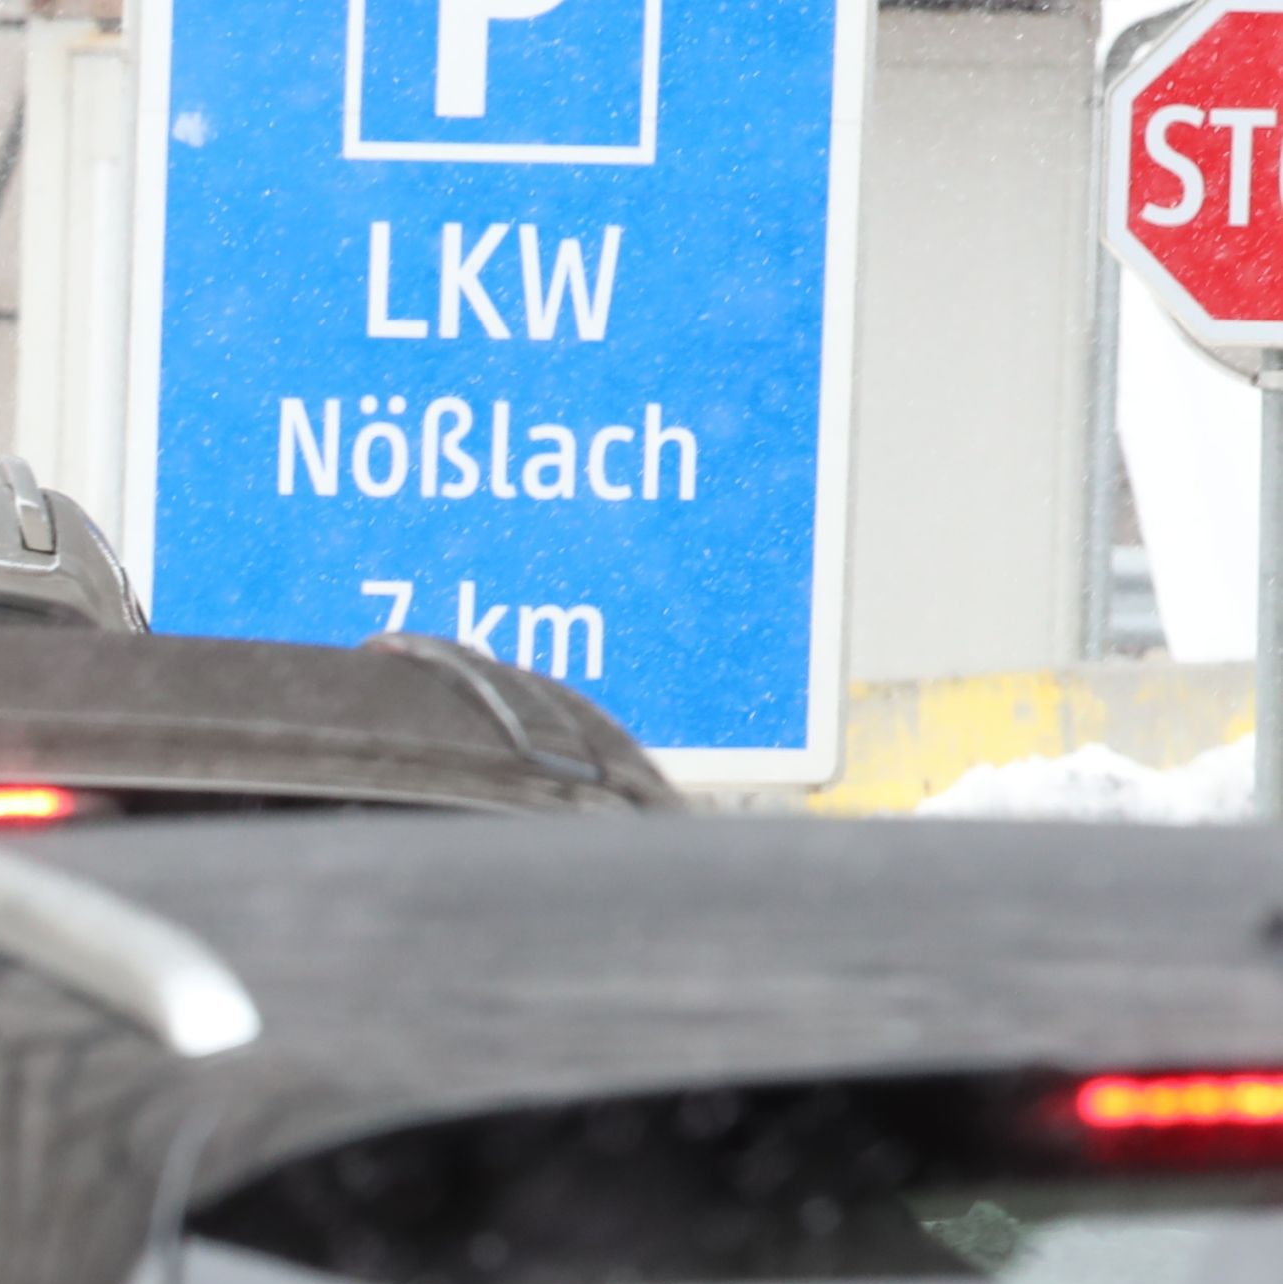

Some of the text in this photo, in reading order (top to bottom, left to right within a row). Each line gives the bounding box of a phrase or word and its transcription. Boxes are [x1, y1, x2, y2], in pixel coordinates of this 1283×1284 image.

[1140, 103, 1283, 227] ST
[366, 221, 622, 342] LKW
[276, 395, 697, 501] Nößlach
[457, 579, 605, 680] km
